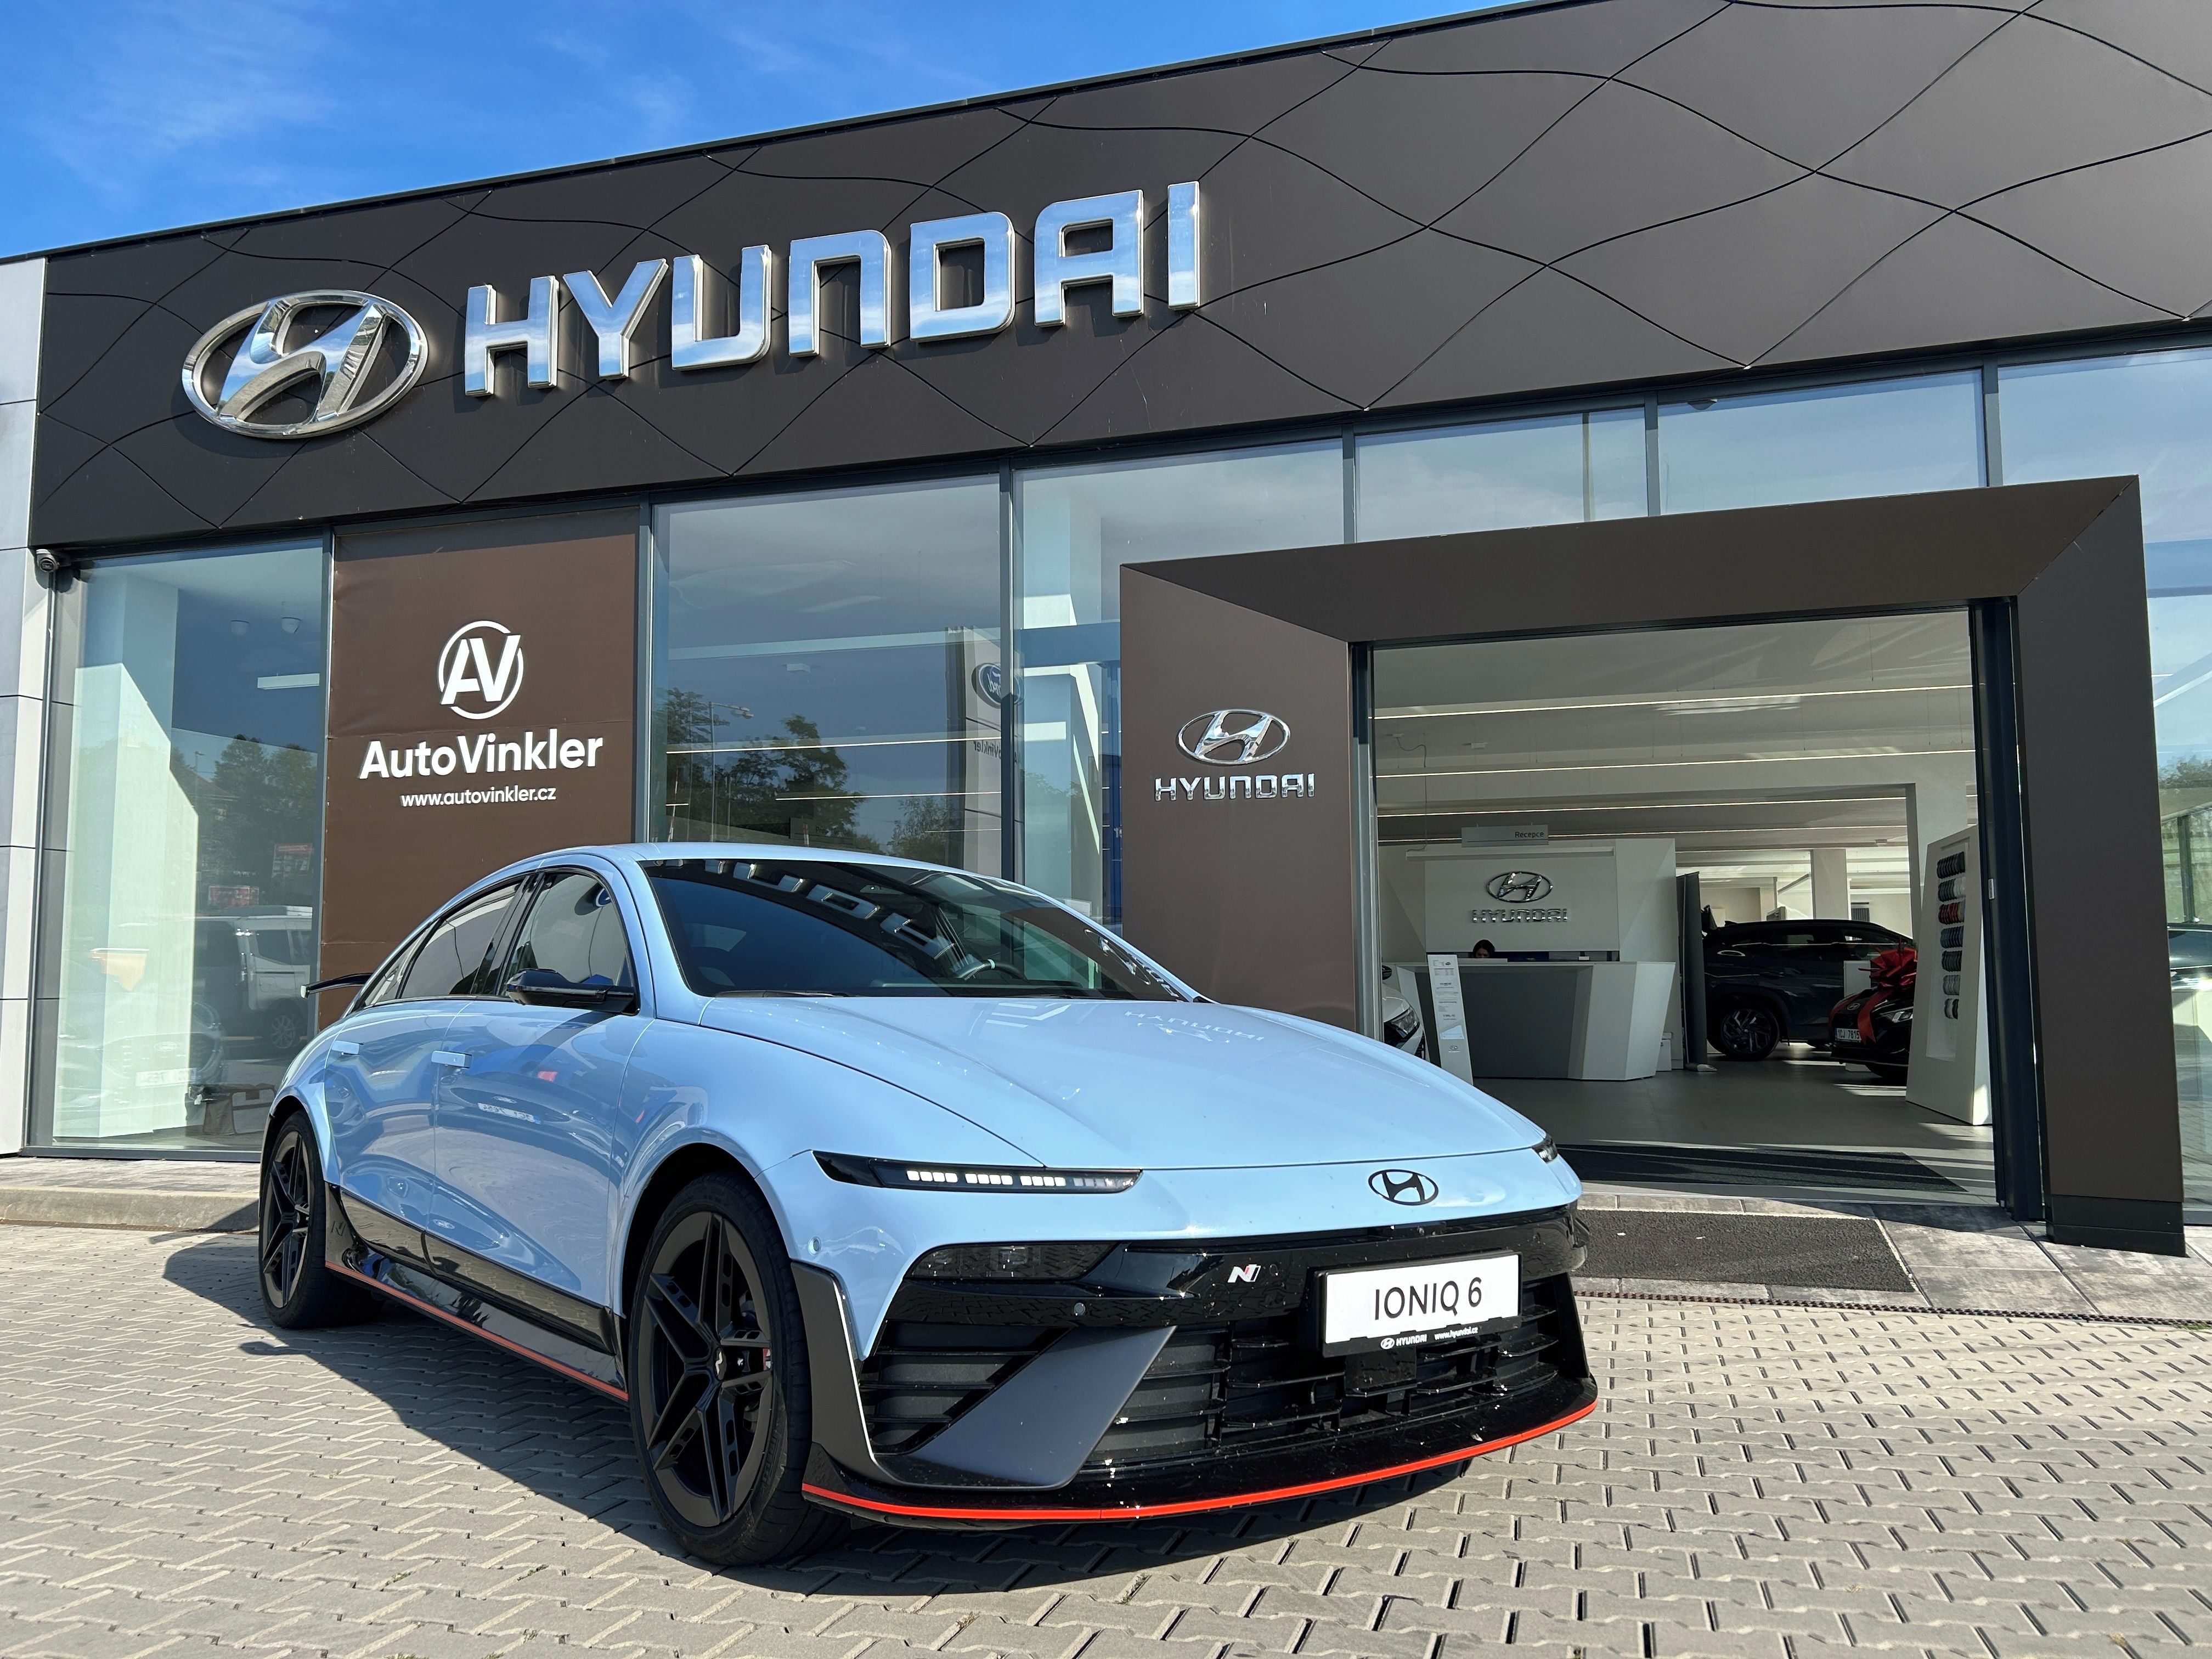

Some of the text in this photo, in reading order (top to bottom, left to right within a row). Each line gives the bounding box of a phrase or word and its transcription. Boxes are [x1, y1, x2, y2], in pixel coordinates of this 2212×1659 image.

[464, 181, 1200, 397] HYUNDAI
[358, 728, 603, 780] AutoVinkler
[400, 785, 557, 808] www.autovinkler.cz
[1154, 772, 1315, 802] HYUNDAI
[1471, 908, 1568, 923] HYUNDAI
[1375, 1277, 1482, 1320] IONIQ 6
[1396, 1334, 1427, 1346] HYUNDAI
